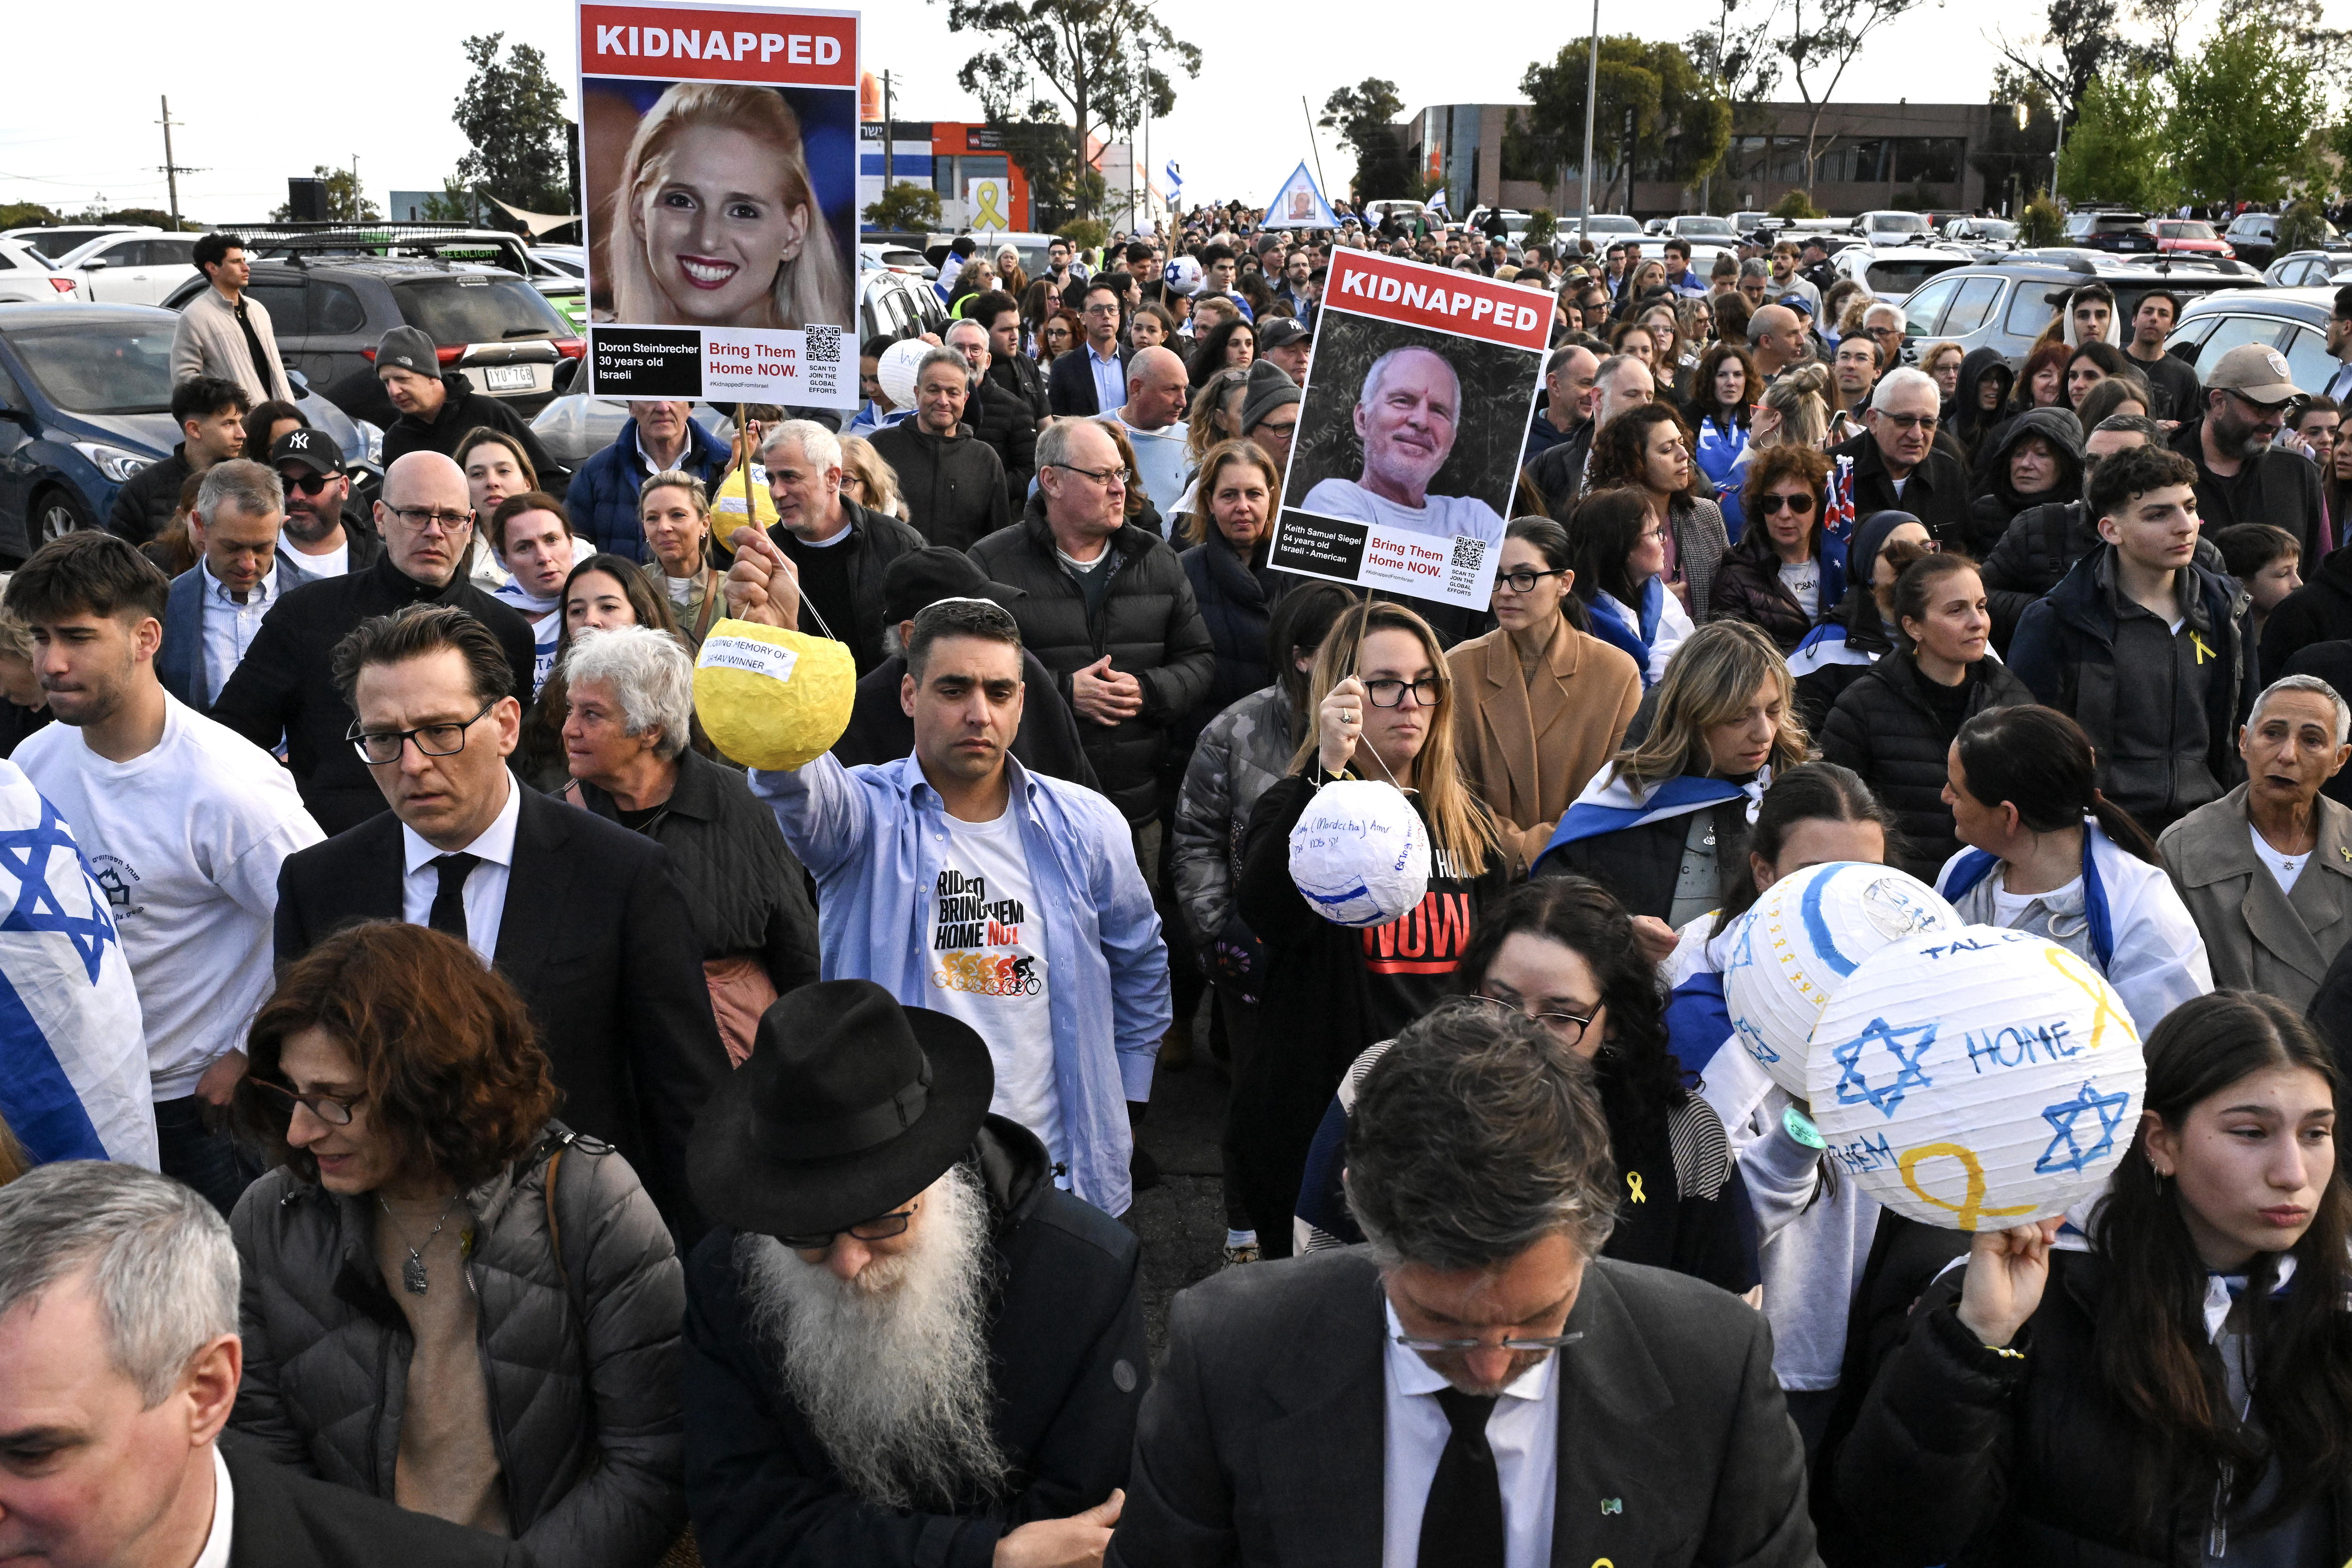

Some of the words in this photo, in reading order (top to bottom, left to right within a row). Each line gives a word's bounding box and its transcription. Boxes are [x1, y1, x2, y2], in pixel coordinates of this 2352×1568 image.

[597, 25, 841, 65] KIDNAPPED
[861, 126, 883, 136] ישר
[438, 249, 498, 258] REENLIGHT
[1341, 269, 1538, 331] KIDNAPPED
[598, 342, 630, 352] Doron
[633, 343, 699, 353] Steinbrecher
[709, 342, 749, 359] Bring
[755, 344, 795, 358] Them
[599, 356, 612, 366] 30
[614, 358, 644, 367] years
[646, 358, 663, 366] old
[901, 348, 923, 366] WA
[600, 370, 631, 379] Israeli
[710, 361, 753, 375] Home
[758, 363, 798, 377] NOW.
[289, 432, 309, 448] NY
[1285, 524, 1305, 533] Keith
[1307, 528, 1336, 540] Samuel
[1337, 534, 1361, 545] Siegel
[1294, 537, 1315, 546] years
[1281, 544, 1304, 555] Israeli
[1310, 549, 1347, 563] American
[1372, 537, 1405, 556] Bring
[1410, 545, 1443, 561] Them
[1368, 553, 1404, 569] Home
[1407, 561, 1441, 578] NOW.
[1365, 570, 1414, 583] #KidnappedFromIsrael
[1795, 580, 1817, 590] C&M
[1447, 587, 1471, 597] EFFORTS
[1449, 581, 1471, 590] GLOBAL
[733, 641, 773, 655] MEMORY
[774, 651, 788, 660] OF
[729, 655, 764, 669] WINNER
[939, 896, 987, 923] BRING
[983, 899, 1025, 926] HEM
[934, 923, 985, 949] HOME
[1920, 939, 2001, 959] TAL
[1965, 1021, 2085, 1074] HOME
[1828, 1131, 1899, 1176] THEM
